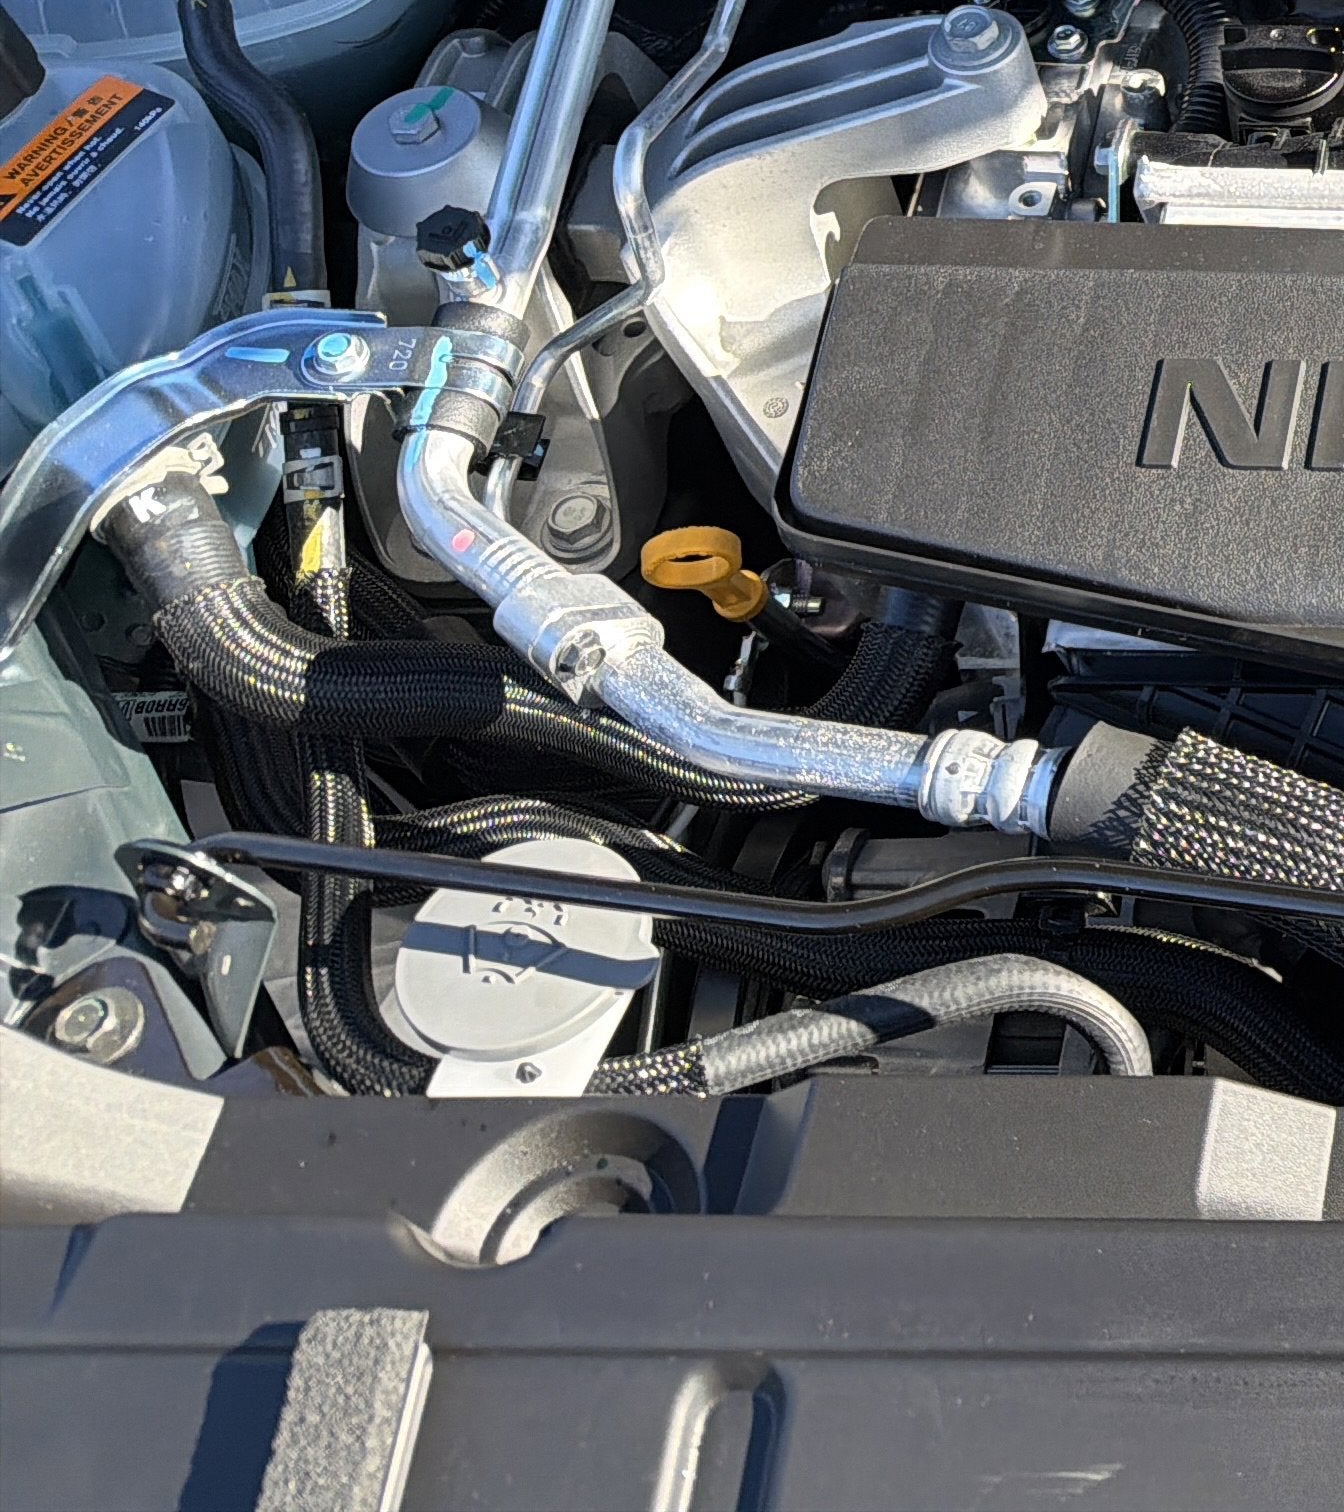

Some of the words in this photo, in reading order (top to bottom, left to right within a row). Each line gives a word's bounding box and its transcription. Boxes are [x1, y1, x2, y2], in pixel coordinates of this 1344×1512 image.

[3, 127, 68, 180] WARNING
[20, 93, 123, 187] AVERTISSEMENT
[16, 191, 40, 214] Never
[42, 171, 63, 190] open
[63, 151, 85, 170] when
[388, 338, 417, 372] 720
[128, 487, 167, 523] K
